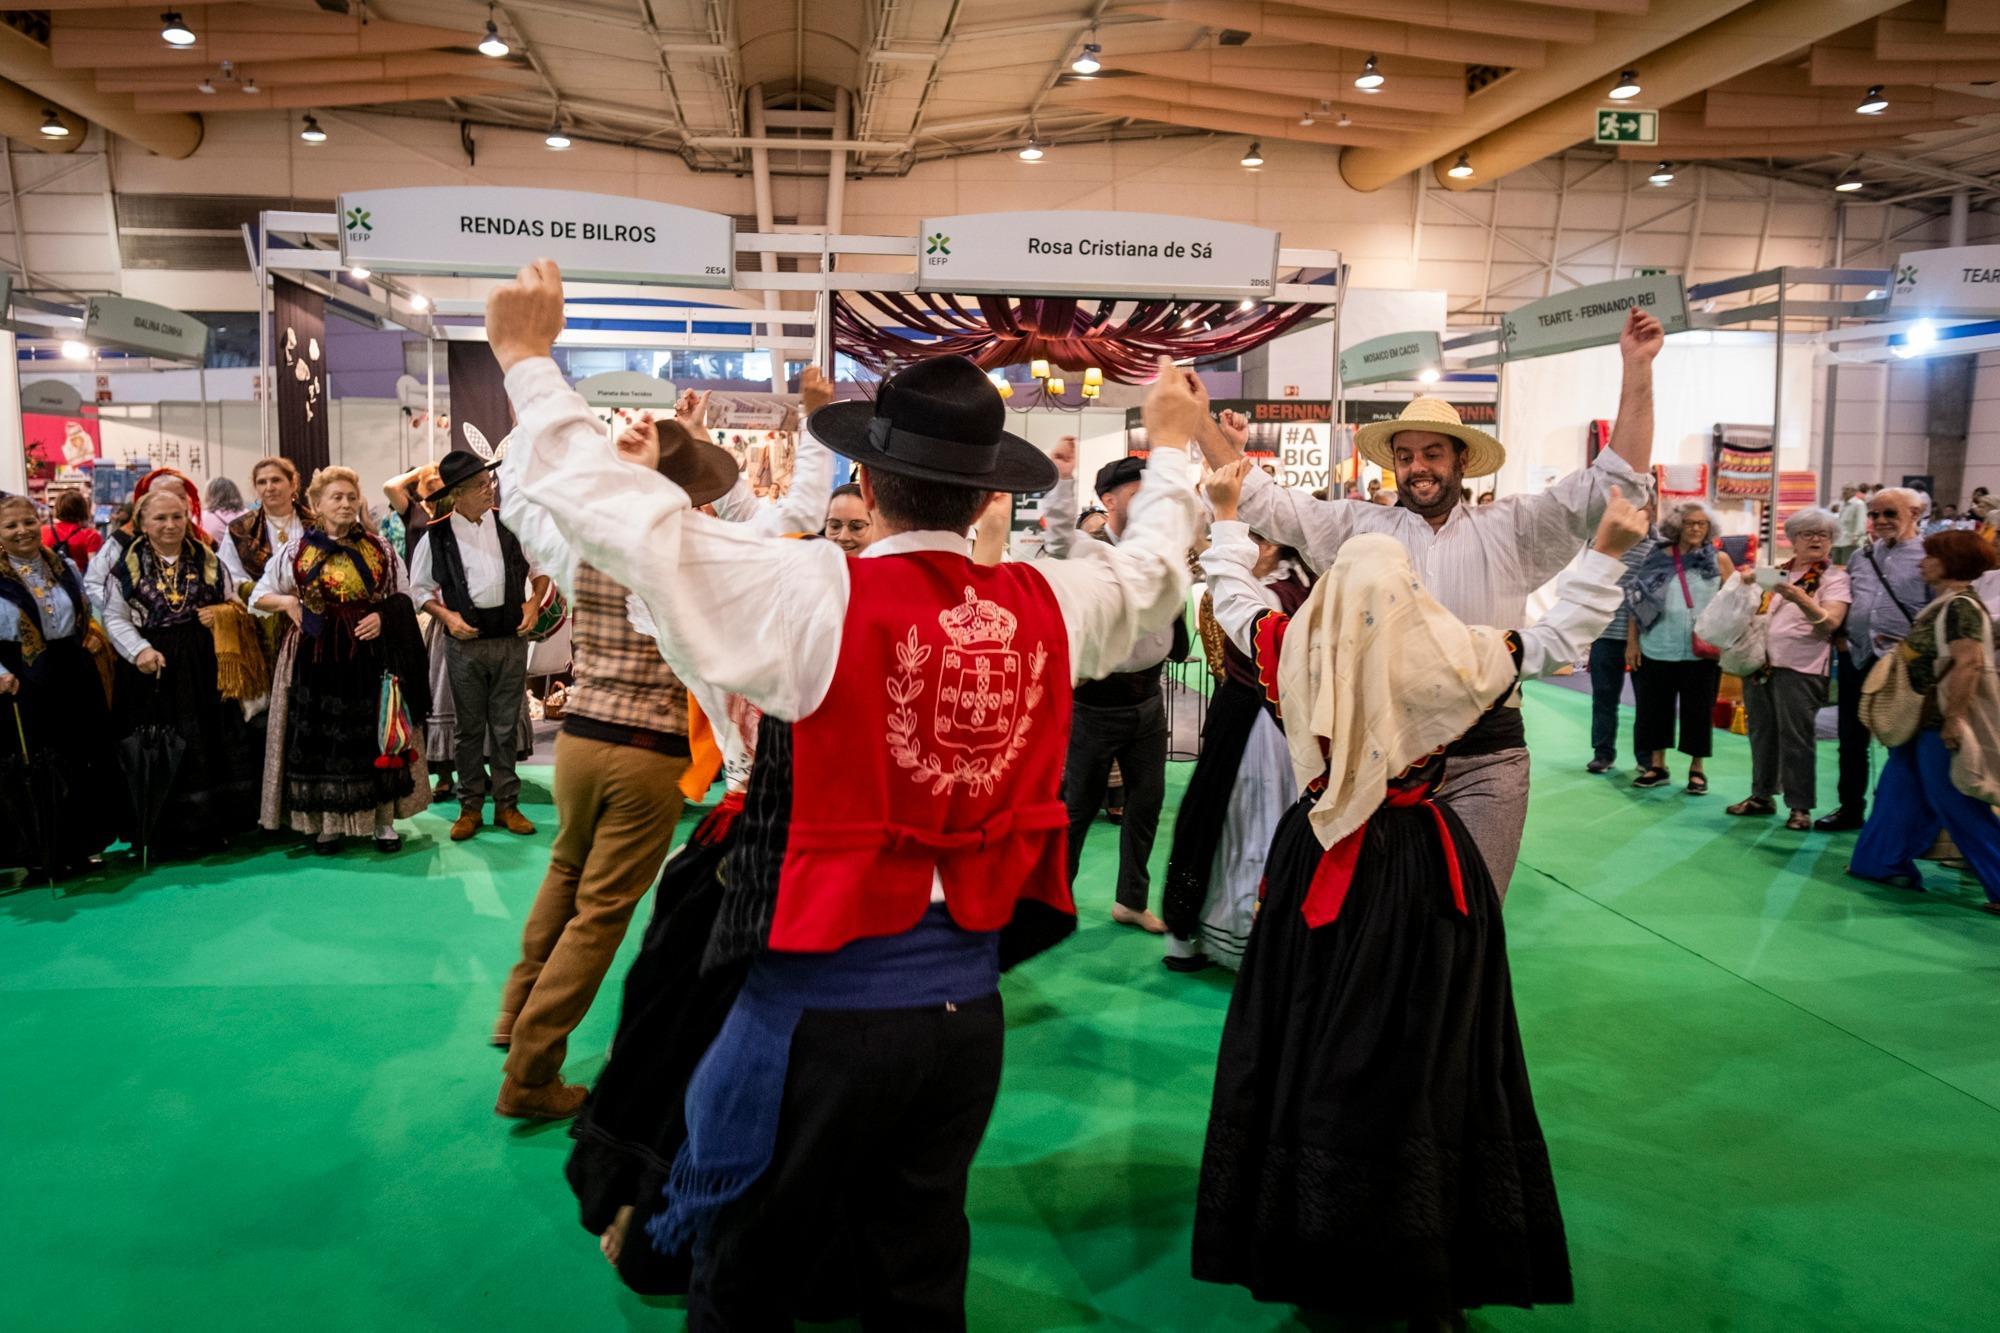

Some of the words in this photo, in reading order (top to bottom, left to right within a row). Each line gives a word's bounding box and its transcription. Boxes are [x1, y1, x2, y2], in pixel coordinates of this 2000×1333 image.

[350, 233, 371, 242] IEFP
[460, 216, 545, 237] RENDAS
[550, 221, 577, 239] DE
[583, 223, 656, 243] BILROS
[1028, 238, 1073, 255] Rosa
[1078, 239, 1158, 258] Cristiana
[1164, 241, 1185, 258] de
[1190, 242, 1213, 259] Sá
[705, 266, 726, 275] 2E54
[928, 257, 948, 266] IEFP
[1538, 310, 1573, 328] TEARTE
[1580, 296, 1636, 320] FERNANDO
[1638, 292, 1656, 307] REI
[1363, 349, 1389, 364] MOSAICO
[1390, 347, 1399, 359] EM
[1399, 343, 1420, 357] CACOS
[1285, 427, 1317, 445] #A
[1284, 449, 1322, 467] BIG
[1285, 470, 1330, 488] DAY
